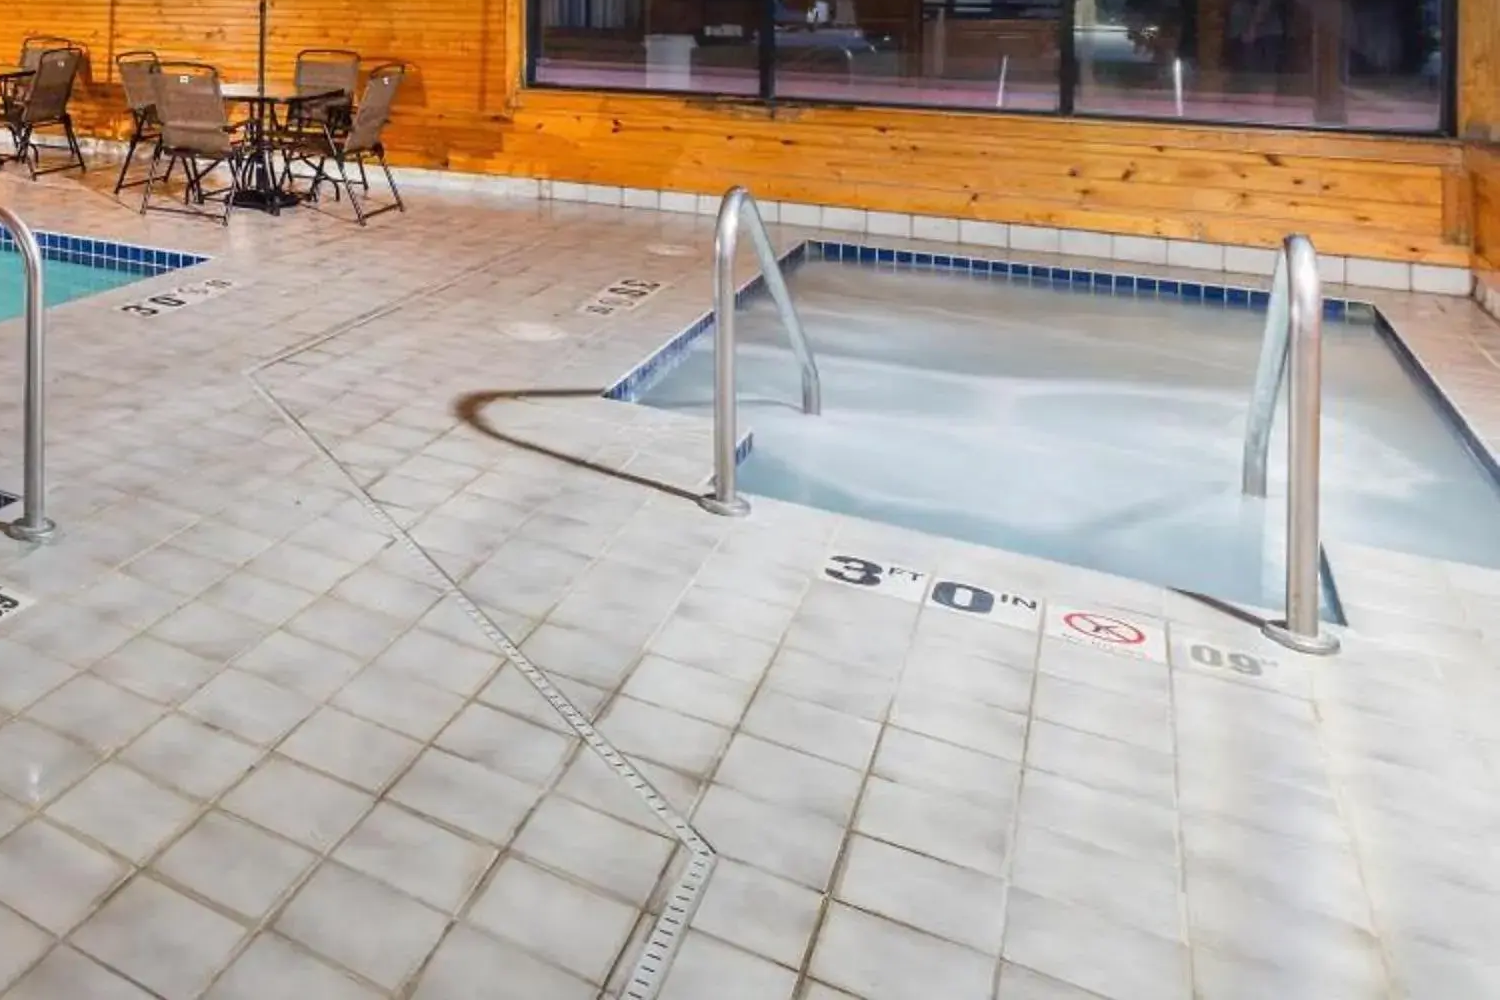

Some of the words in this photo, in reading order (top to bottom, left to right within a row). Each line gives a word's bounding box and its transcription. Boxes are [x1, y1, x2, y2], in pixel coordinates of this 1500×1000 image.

[825, 555, 883, 586] 3
[931, 581, 995, 614] 0
[1000, 594, 1037, 610] IN
